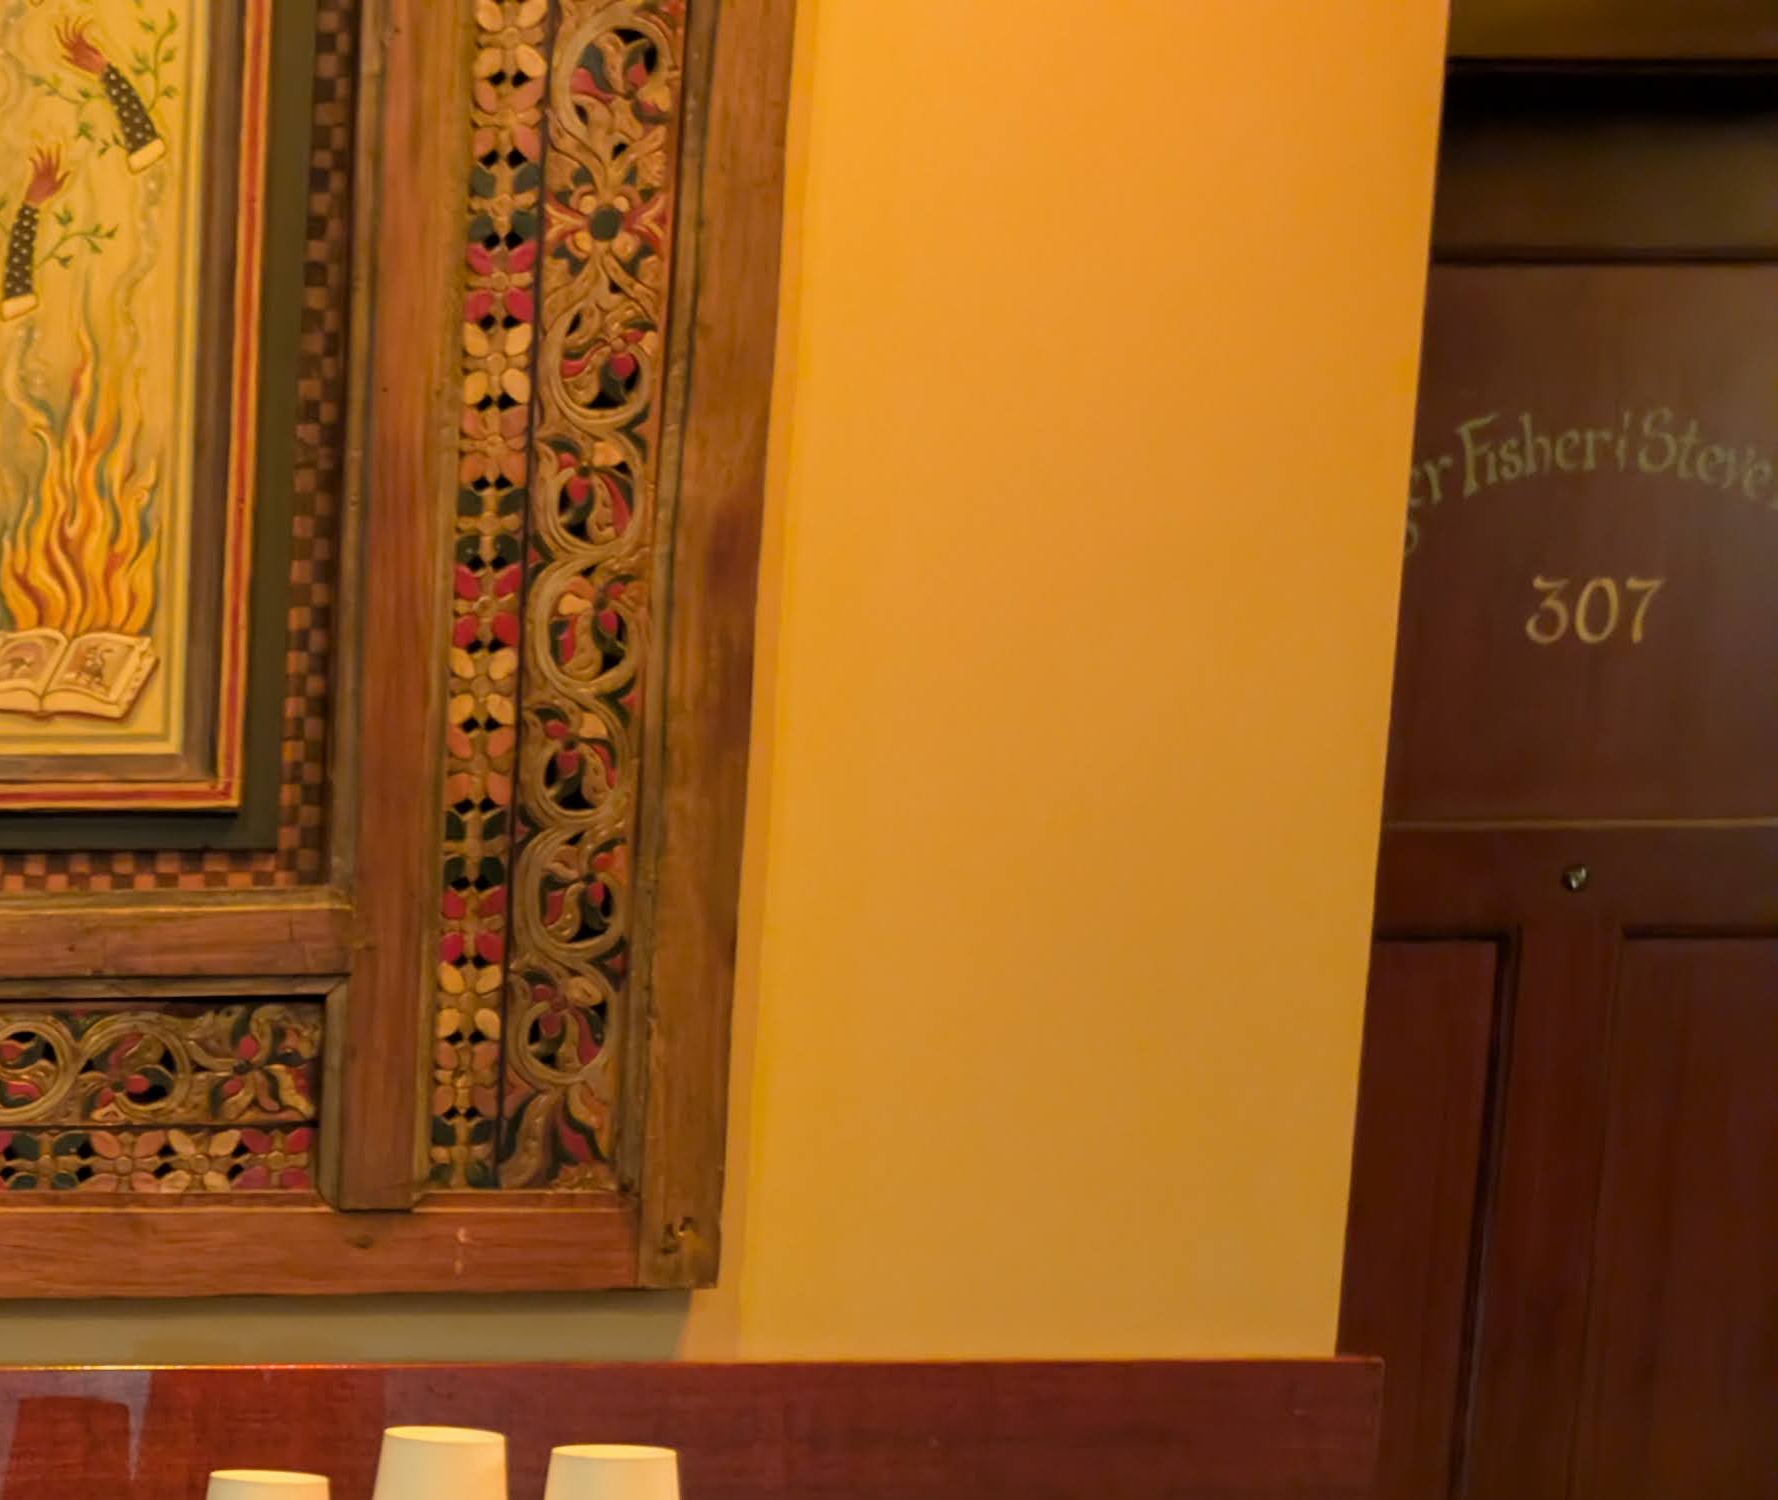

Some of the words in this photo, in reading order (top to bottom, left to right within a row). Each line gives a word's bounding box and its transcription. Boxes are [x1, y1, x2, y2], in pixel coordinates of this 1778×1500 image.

[1456, 411, 1613, 498] Fisher
[1638, 405, 1778, 510] Steve
[1525, 575, 1665, 644] 307
